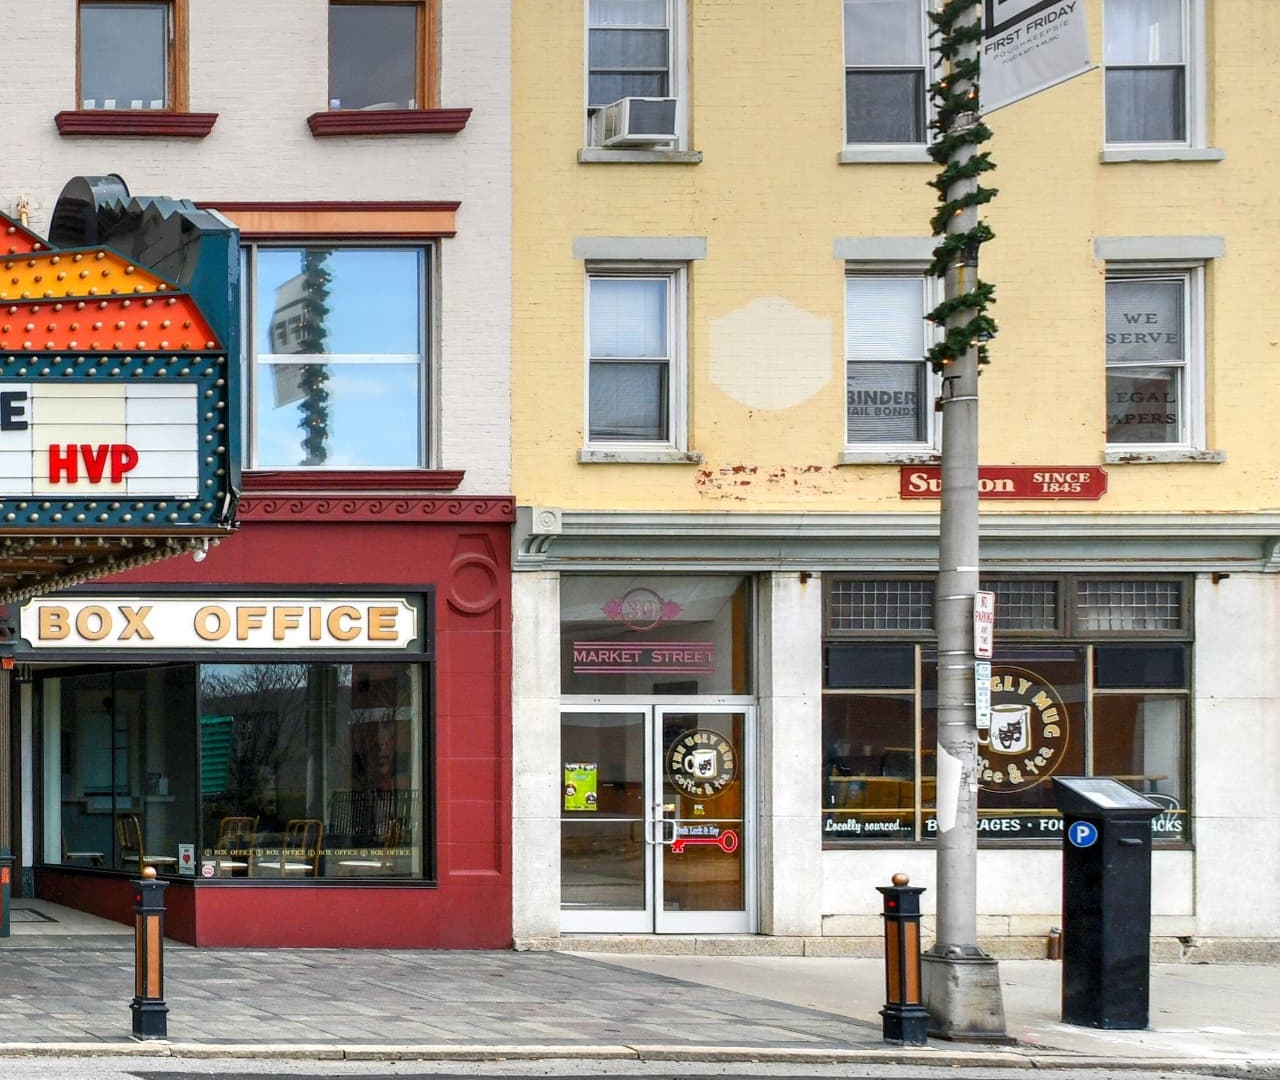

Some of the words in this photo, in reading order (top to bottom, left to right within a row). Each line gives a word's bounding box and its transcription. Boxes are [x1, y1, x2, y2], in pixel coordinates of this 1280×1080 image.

[984, 28, 1022, 56] FIRST
[1026, 0, 1077, 34] FRIDAY
[1123, 313, 1158, 324] WE
[1105, 332, 1178, 344] SERVE
[875, 406, 919, 416] BONDS
[47, 443, 140, 485] HVP
[908, 472, 1016, 493] Suon
[1032, 472, 1090, 483] SINCE
[1041, 482, 1082, 493] 1845
[37, 605, 155, 641] BOX
[193, 605, 400, 641] OFFICE
[573, 650, 643, 663] MARKET
[651, 650, 714, 663] STREET
[991, 675, 1033, 695] GLY
[1031, 690, 1061, 738] MUG
[684, 733, 718, 748] UGLY
[1024, 746, 1055, 774] tea
[674, 773, 703, 795] coffee
[825, 819, 862, 833] Locally
[864, 820, 912, 832] sourced...
